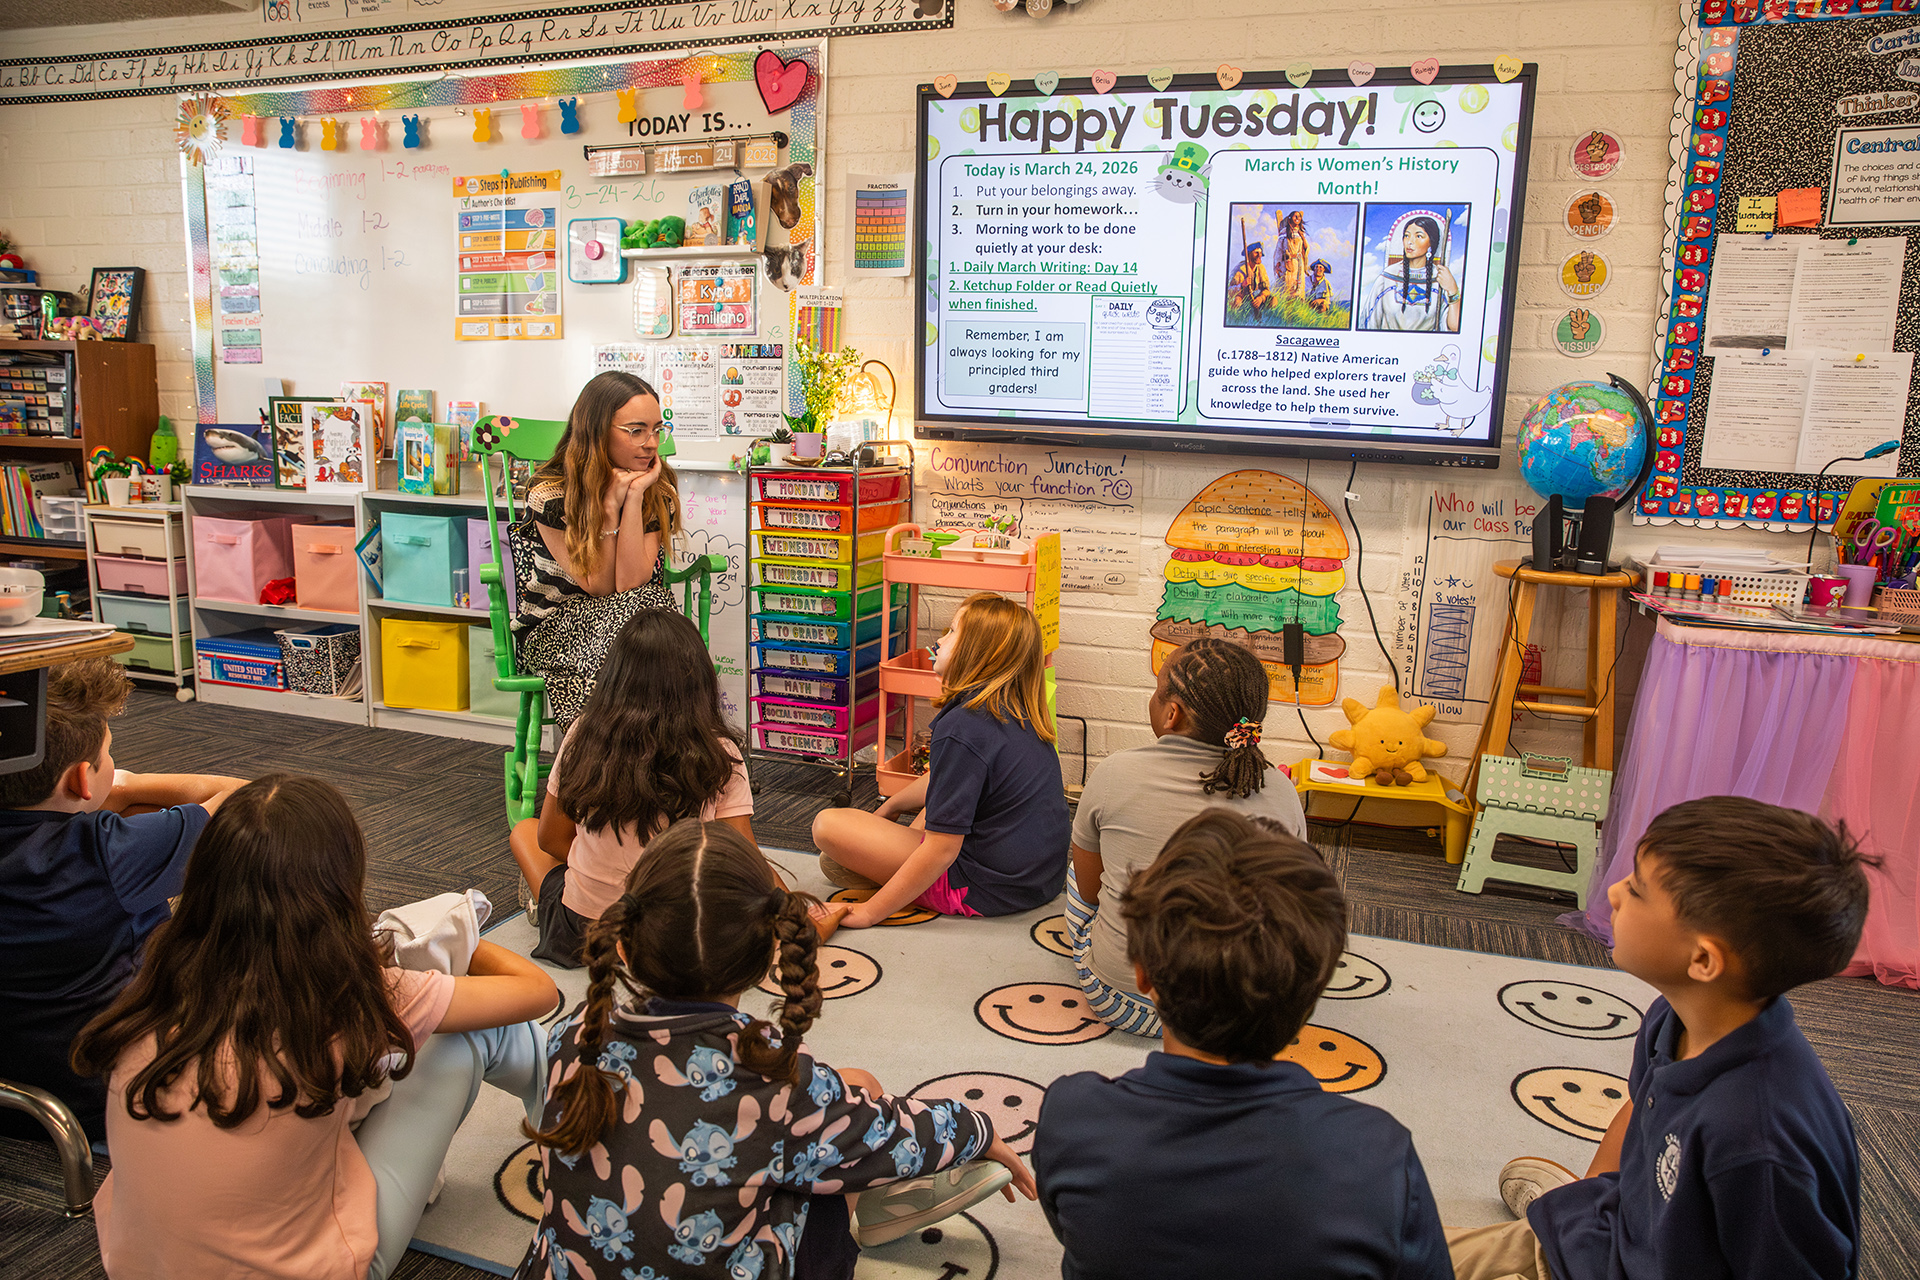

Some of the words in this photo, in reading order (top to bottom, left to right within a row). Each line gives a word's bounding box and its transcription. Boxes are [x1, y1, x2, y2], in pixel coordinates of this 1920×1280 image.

[1352, 68, 1372, 76] Connor
[1415, 66, 1435, 75] Raleigh
[1497, 63, 1517, 74] Austin
[1095, 76, 1111, 84] Bella
[1220, 73, 1234, 82] Mia
[1839, 93, 1918, 115] Thinker
[627, 113, 690, 137] TODAY
[978, 102, 1136, 153] Happy
[1153, 92, 1378, 147] Tuesday!
[664, 152, 703, 165] March
[716, 148, 732, 162] 24
[746, 148, 776, 162] 2026
[964, 163, 1004, 178] Today
[1006, 162, 1021, 176] is
[1024, 160, 1071, 177] March
[1075, 161, 1097, 176] 24,
[1102, 160, 1139, 175] 2026
[1245, 158, 1295, 172] March
[1300, 157, 1312, 171] is
[1399, 156, 1459, 174] History
[1843, 164, 1860, 172] The
[1862, 163, 1894, 171] choices
[1896, 161, 1914, 170] and
[295, 168, 366, 200] Beginning
[480, 179, 500, 193] Steps
[510, 175, 547, 191] Publishing
[1846, 174, 1859, 183] of
[1860, 173, 1880, 183] living
[1883, 172, 1910, 183] things
[566, 175, 665, 209] 3-24-26
[952, 186, 963, 198] 1.
[976, 185, 996, 197] Put
[997, 187, 1028, 201] your
[1031, 183, 1098, 201] belongings
[1101, 186, 1137, 199] away.
[1317, 181, 1379, 196] Month!
[1837, 185, 1872, 194] survival,
[1748, 198, 1761, 210] I
[1839, 196, 1867, 205] health
[1869, 196, 1880, 204] of
[1883, 195, 1905, 204] their
[1738, 210, 1775, 221] wonder
[1572, 225, 1607, 235] PENCIL
[295, 252, 371, 291] Concluding
[699, 284, 733, 301] Kyra
[949, 281, 959, 291] 2.
[963, 280, 1012, 294] Ketchup
[1016, 280, 1055, 291] Folder
[1059, 283, 1072, 292] or
[1075, 281, 1106, 292] Read
[1110, 281, 1158, 295] Quietly
[1566, 283, 1602, 294] WATER
[949, 299, 982, 310] when
[985, 298, 1037, 311] finished.
[1109, 302, 1133, 310] DAILY
[690, 309, 745, 326] Emiliano
[965, 329, 1030, 343] Remember,
[1034, 331, 1041, 341] I
[1045, 333, 1064, 342] am
[1276, 335, 1340, 348] Sacagawea
[738, 344, 758, 357] THE
[761, 344, 782, 357] RUG
[1560, 341, 1597, 351] TISSUE
[598, 351, 645, 362] MORNING
[949, 348, 988, 360] always
[991, 348, 1034, 361] looking
[1039, 348, 1059, 360] for
[1062, 350, 1080, 362] my
[1301, 352, 1339, 365] Native
[1342, 353, 1399, 366] American
[968, 364, 1026, 379] principled
[1030, 366, 1059, 377] third
[988, 384, 1037, 396] graders!
[411, 402, 428, 410] Cycles
[931, 447, 1028, 475] Conjunction
[1044, 451, 1127, 477] Junction!
[29, 471, 61, 483] Science
[200, 462, 272, 479] SHARKS
[779, 482, 822, 497] MONDAY
[995, 481, 1025, 496] your
[1030, 475, 1096, 496] function
[1192, 501, 1222, 517] Topic
[1227, 503, 1272, 515] Sentence
[1283, 506, 1305, 518] tells
[1311, 509, 1332, 519] what
[1434, 490, 1475, 513] Who
[1482, 499, 1504, 517] will
[1515, 499, 1536, 517] be
[779, 511, 824, 526] TUESDAY
[1443, 518, 1467, 531] our
[1473, 517, 1510, 533] Class
[1192, 521, 1209, 532] the
[1215, 525, 1260, 540] paragraph
[1265, 526, 1280, 536] will
[1283, 526, 1294, 537] be
[1300, 528, 1326, 539] about
[767, 539, 828, 555] WEDNESDAY
[771, 568, 823, 583] THURSDAY
[780, 596, 816, 611] FRIDAY
[1435, 592, 1443, 602] 8
[776, 625, 789, 638] TO
[792, 626, 824, 641] GRADE
[790, 654, 809, 666] ELA
[223, 663, 245, 674] UNITED
[246, 666, 267, 676] STATES
[784, 680, 812, 694] MATH
[766, 707, 792, 719] SOCIAL
[794, 709, 823, 721] STUDIES
[780, 735, 822, 750] SCIENCE
